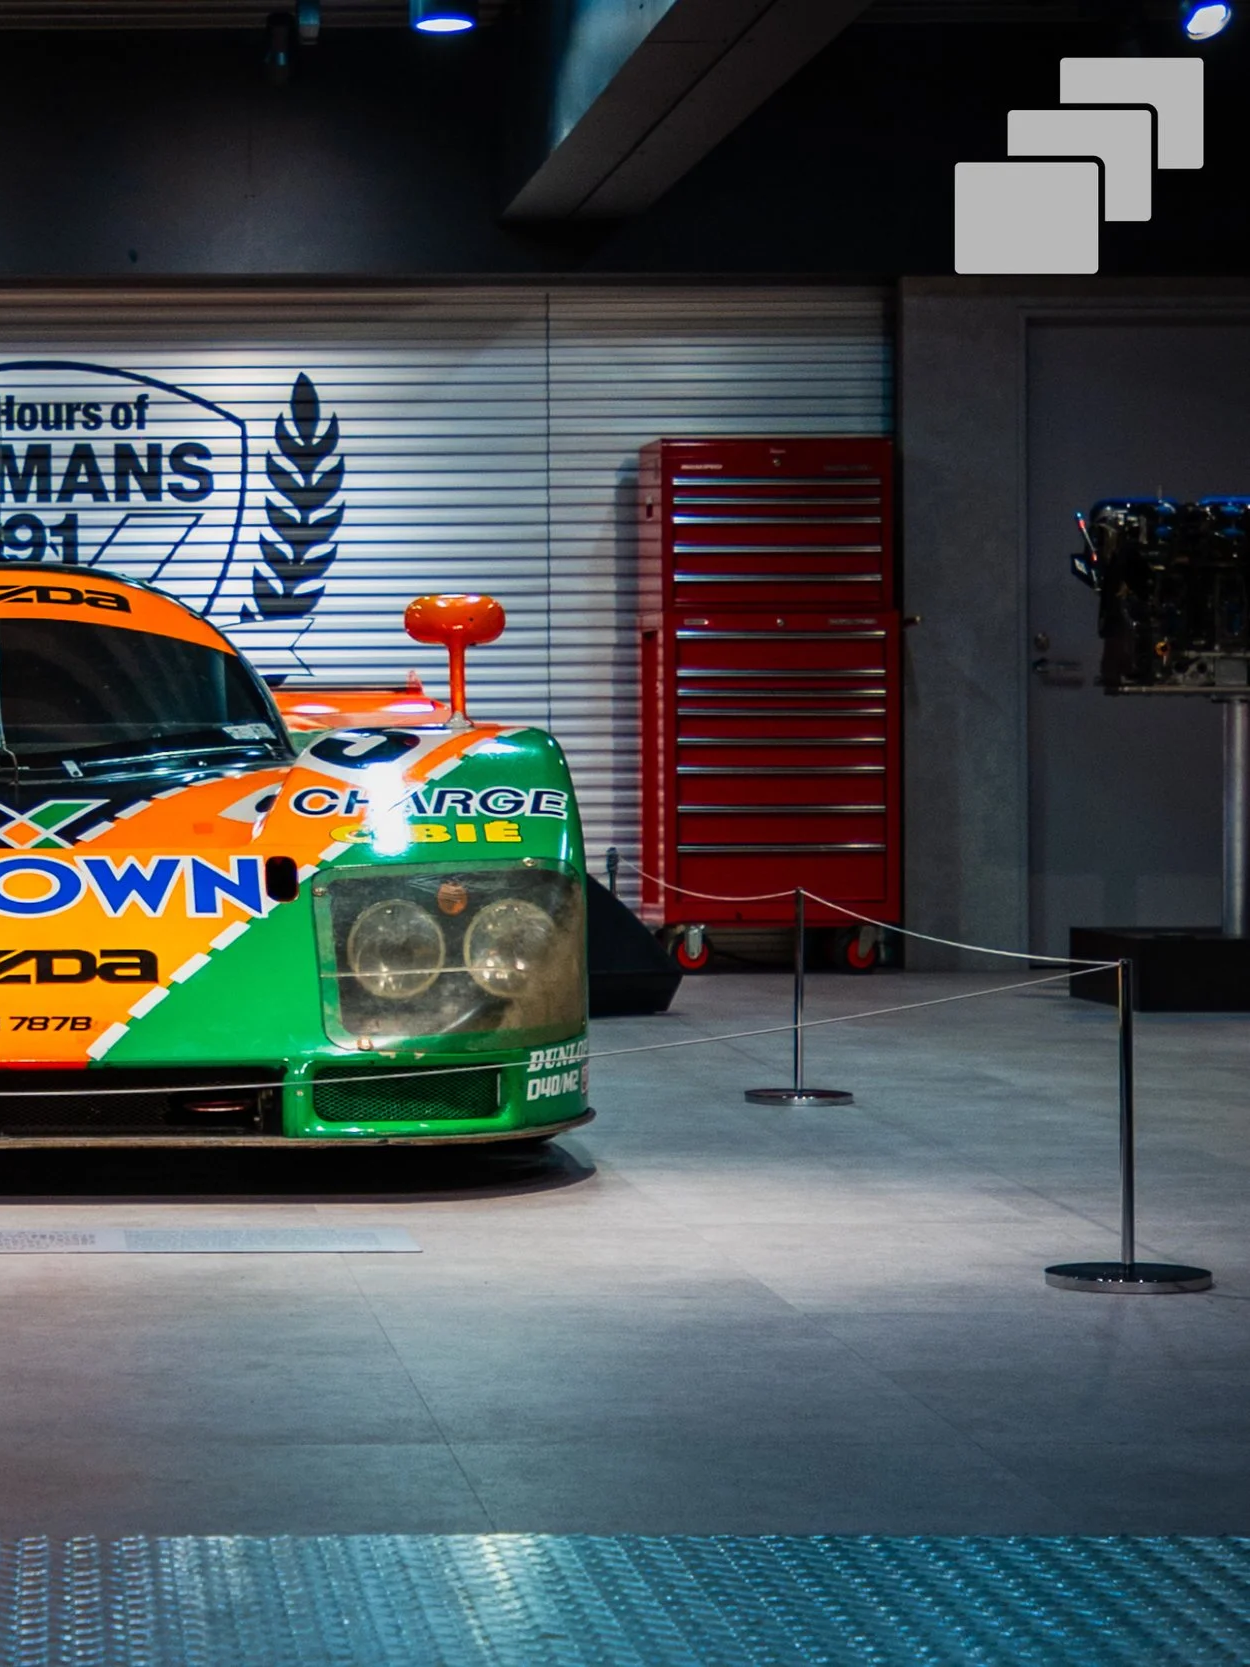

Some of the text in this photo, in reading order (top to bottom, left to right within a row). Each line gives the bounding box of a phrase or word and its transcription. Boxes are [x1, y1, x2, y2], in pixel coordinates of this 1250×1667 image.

[111, 393, 149, 431] of
[329, 820, 522, 844] CBIÉ
[8, 1015, 93, 1032] 787B
